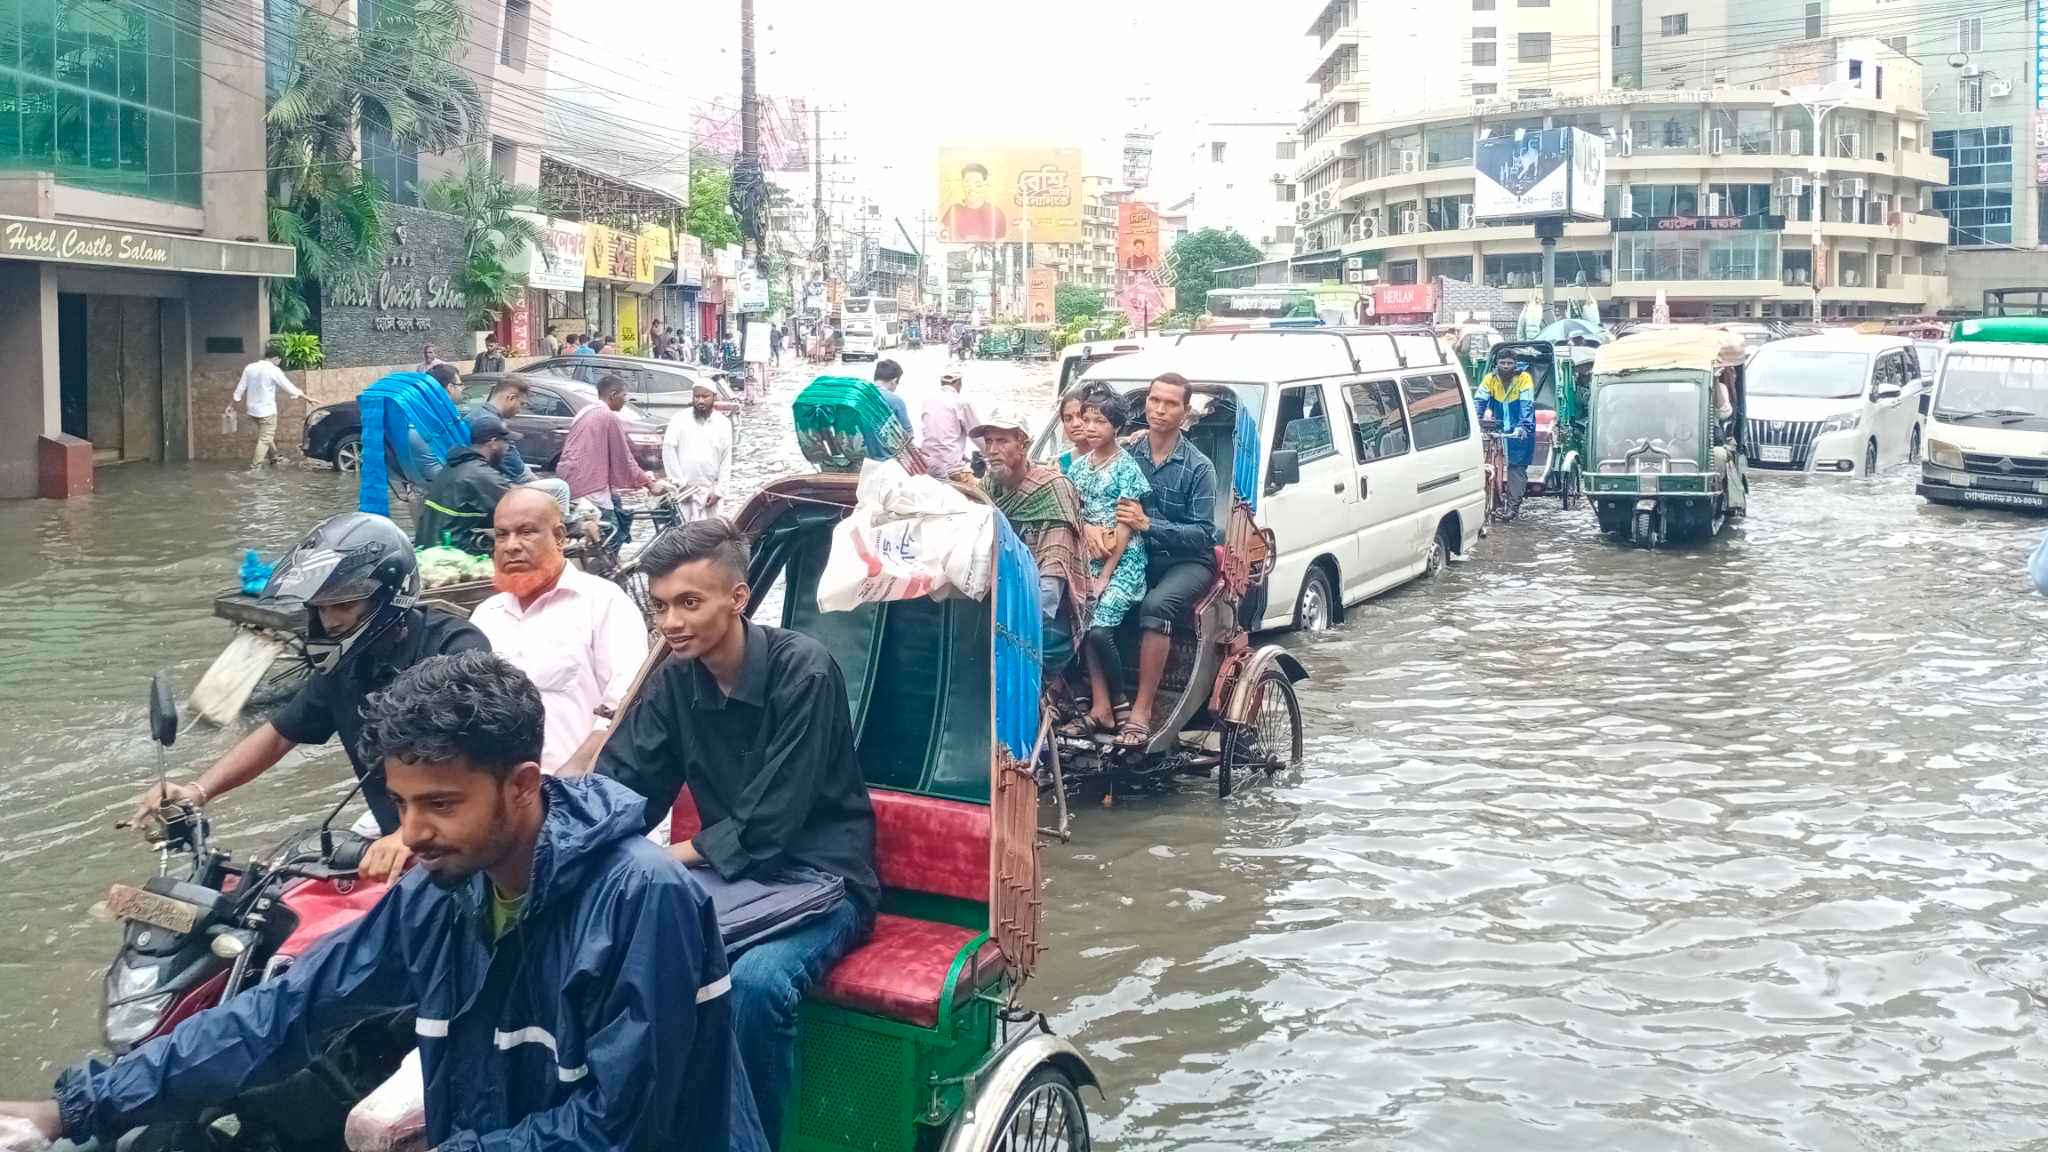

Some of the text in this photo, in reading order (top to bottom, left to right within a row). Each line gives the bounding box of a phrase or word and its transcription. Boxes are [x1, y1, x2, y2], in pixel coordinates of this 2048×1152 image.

[6, 222, 167, 263] Hotel Castle Salam
